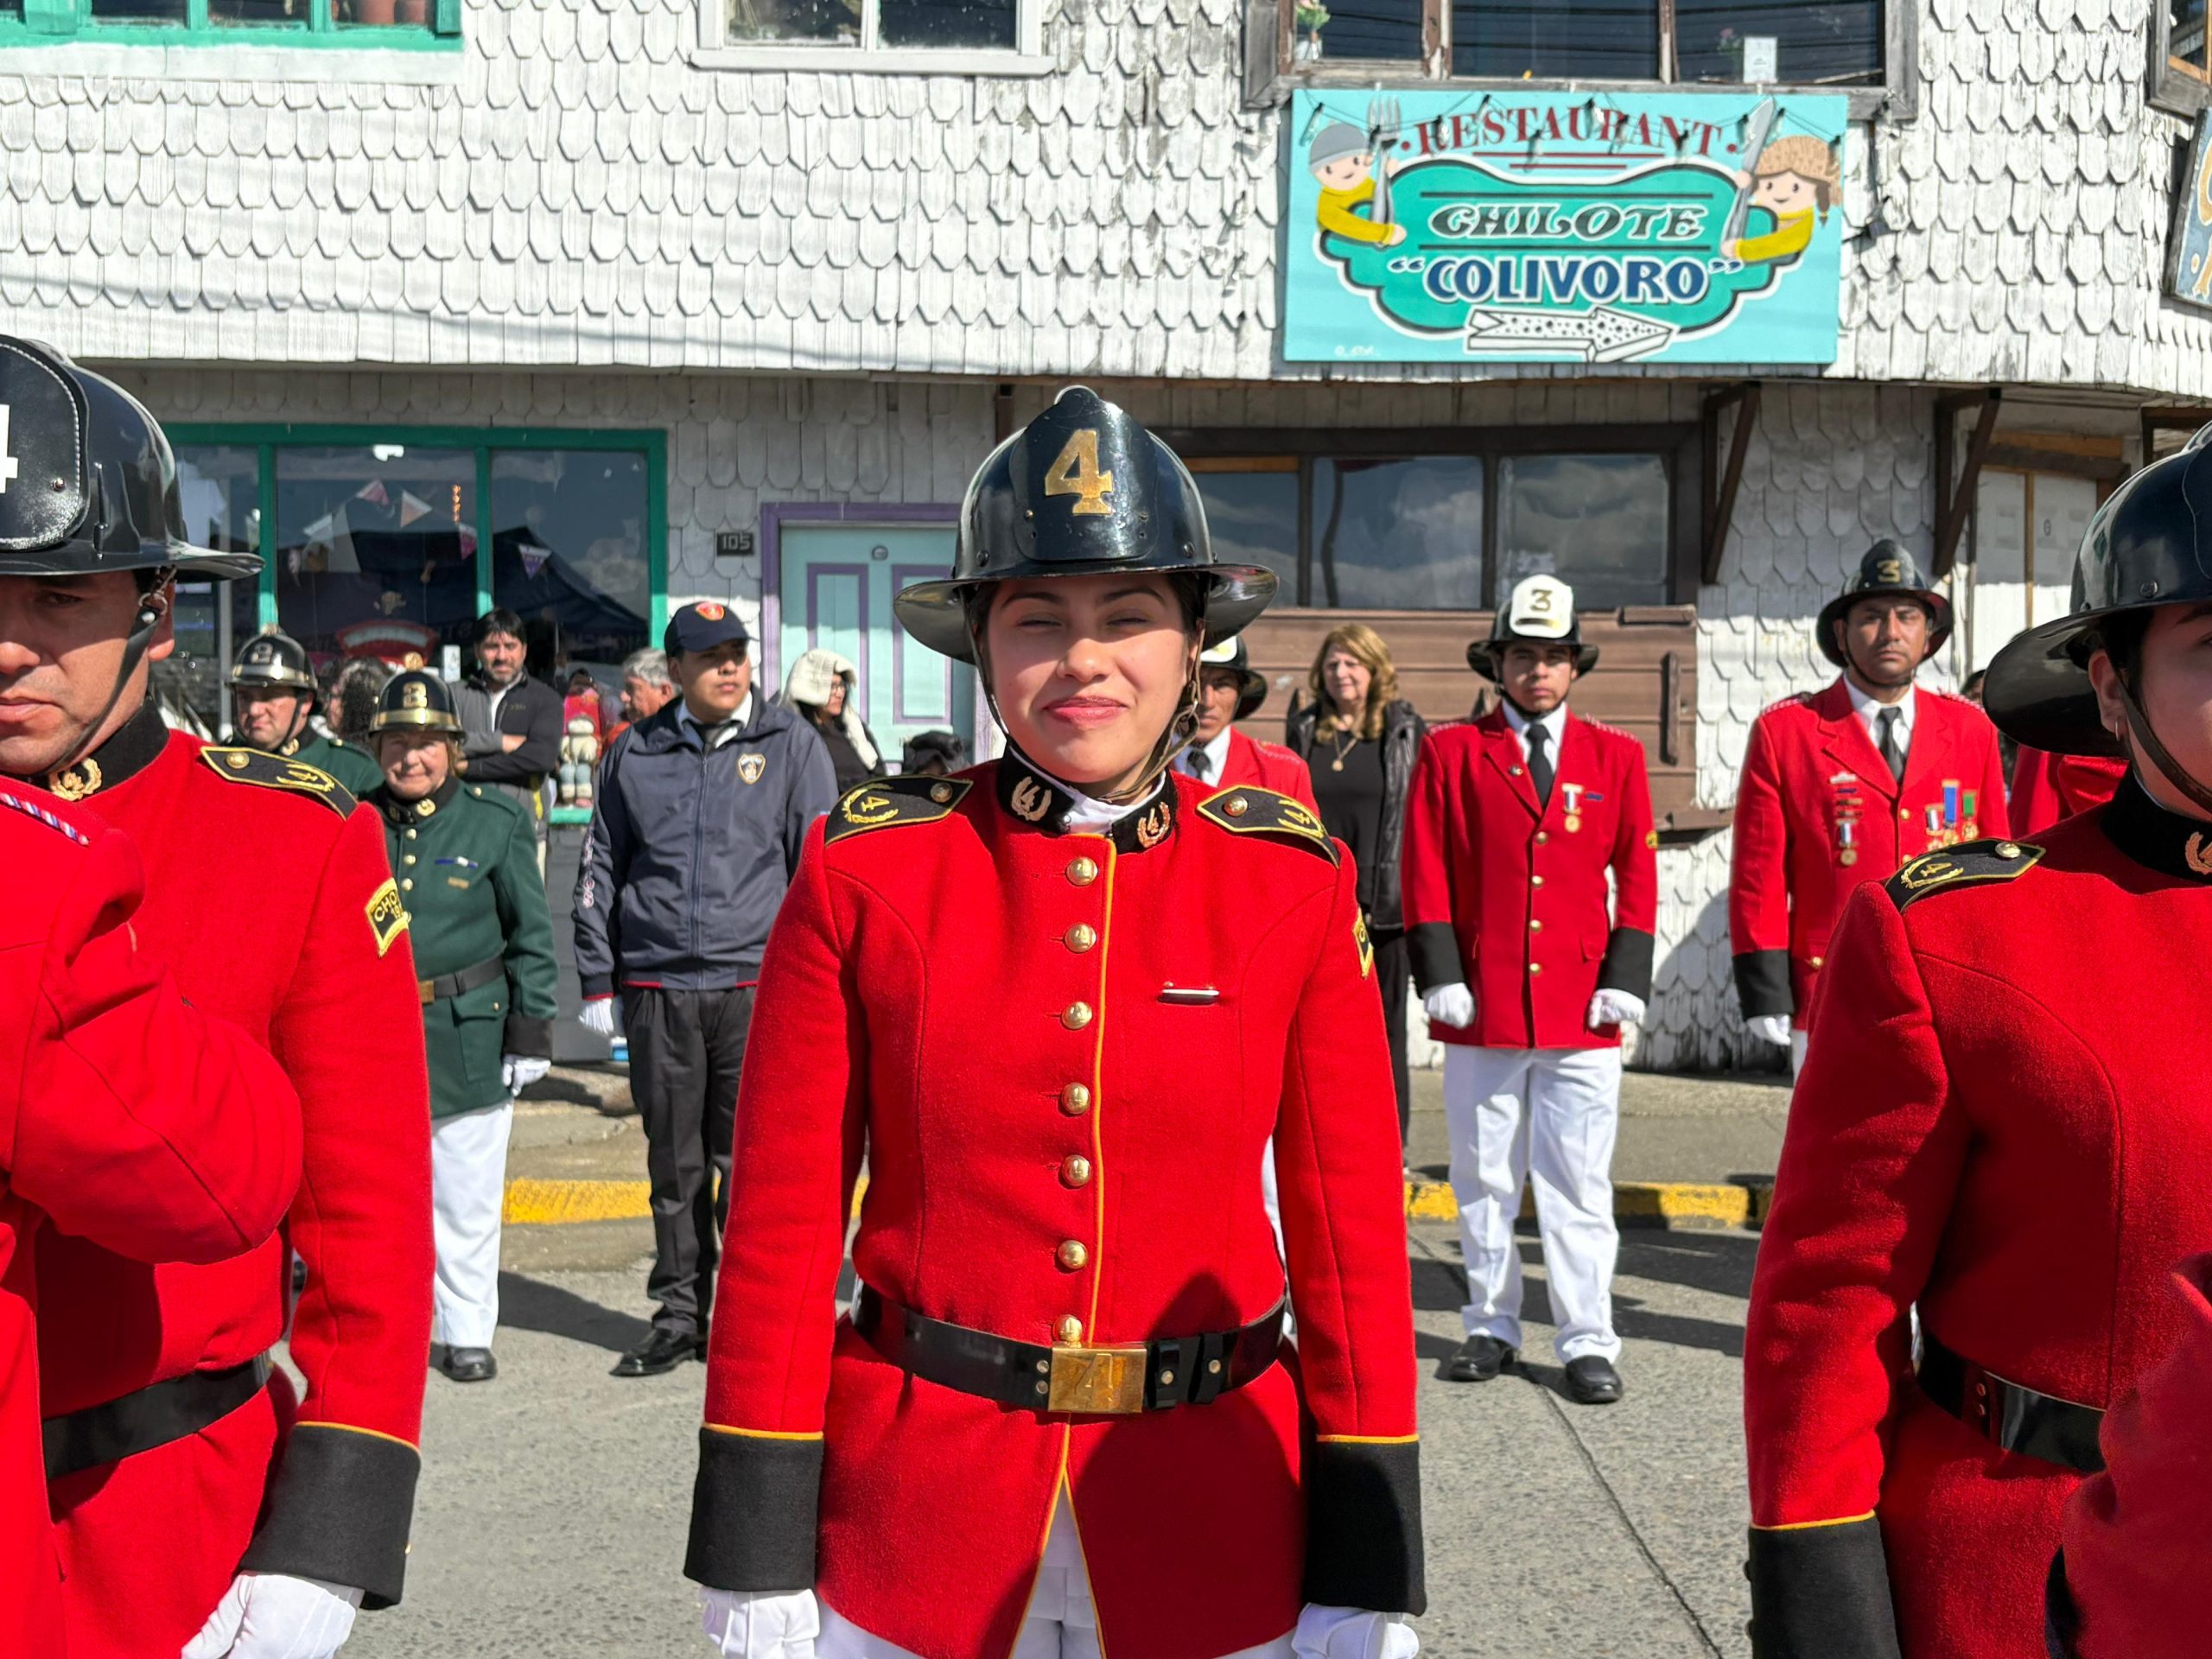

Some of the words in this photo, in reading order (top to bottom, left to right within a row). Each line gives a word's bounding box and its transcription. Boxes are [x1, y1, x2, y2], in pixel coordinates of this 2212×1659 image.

[1430, 204, 1708, 243] CHILOTE
[1045, 429, 1114, 515] 4
[722, 533, 751, 550] 105
[1877, 559, 1901, 583] 3
[1529, 589, 1553, 612] 3
[251, 642, 274, 664] 2
[861, 796, 891, 812] 4
